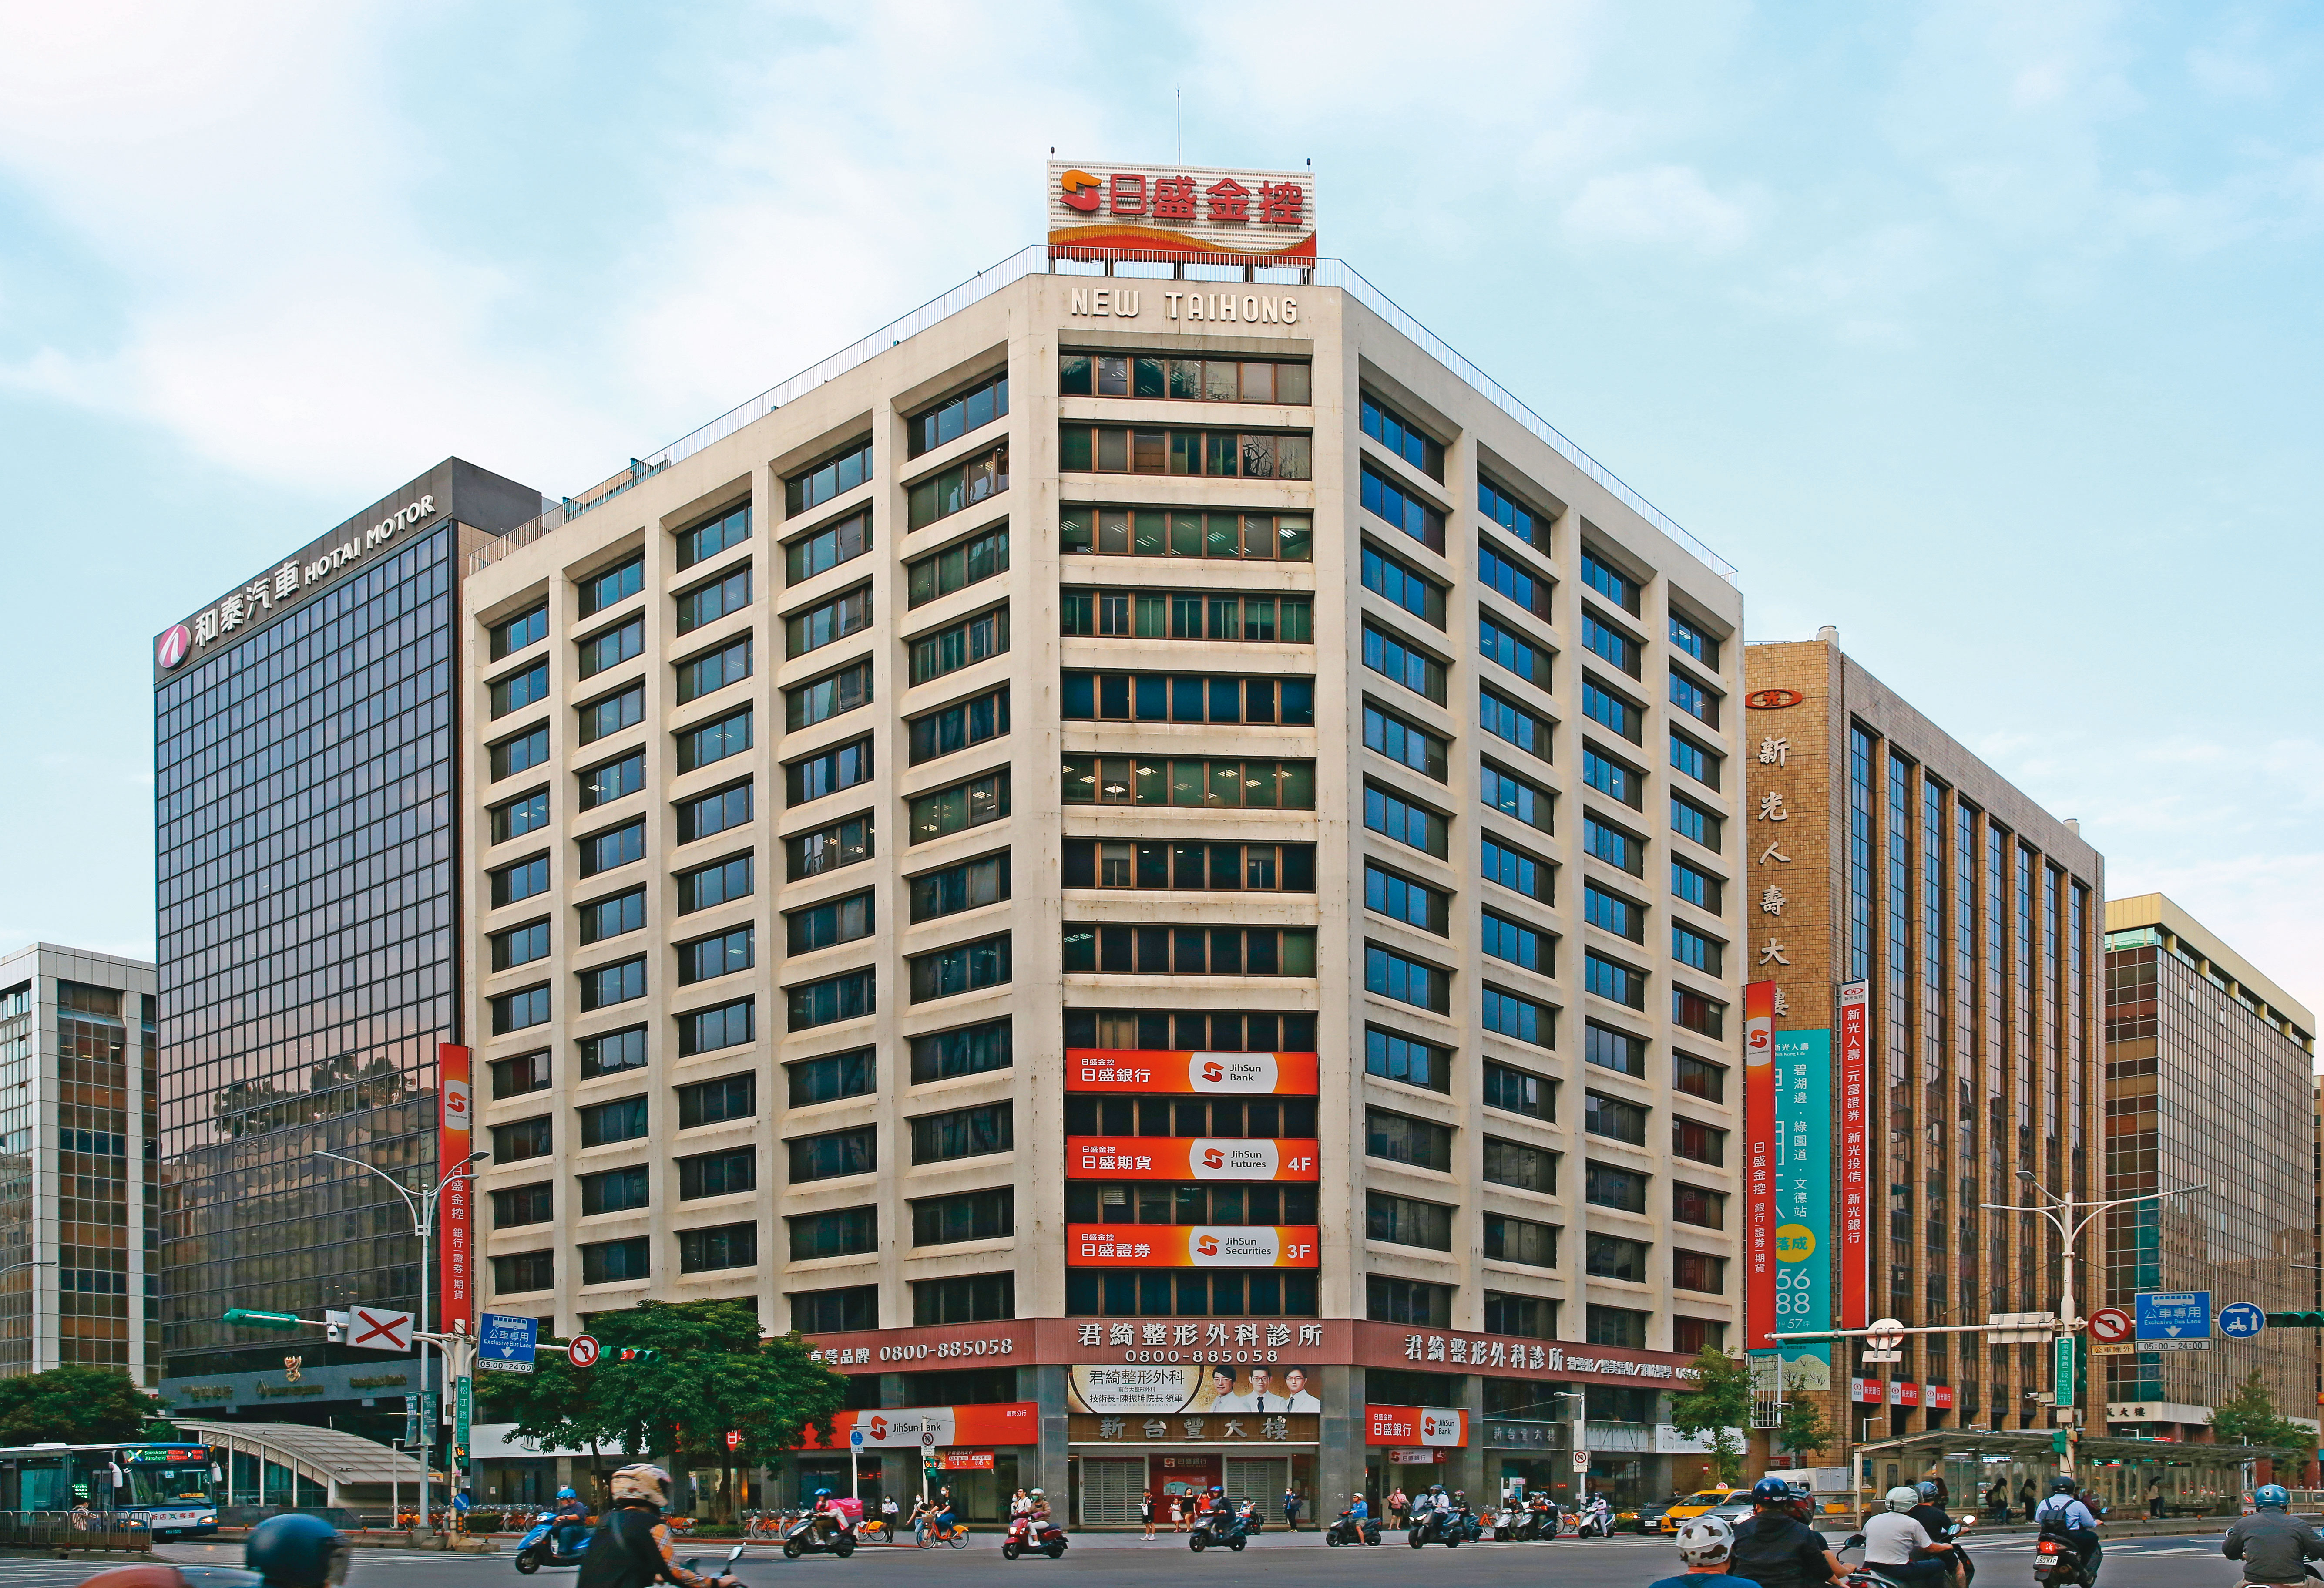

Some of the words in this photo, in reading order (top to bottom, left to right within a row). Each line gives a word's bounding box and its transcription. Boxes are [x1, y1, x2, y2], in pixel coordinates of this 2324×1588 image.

[1110, 174, 1303, 225] 日盛金控
[1071, 287, 1139, 317] NEW
[1165, 291, 1297, 323] TAIHONG
[305, 537, 361, 585] HOTAI
[366, 495, 436, 550] MOTOR
[195, 559, 300, 647] 和泰汽車
[1847, 1009, 1860, 1061] 新光人壽
[1081, 1068, 1151, 1083] 日盛銀行
[1230, 1063, 1262, 1073] JihSun
[1230, 1073, 1254, 1081] Bank
[1847, 1070, 1860, 1122] 元富證券
[1231, 1150, 1262, 1158] JihSun
[1847, 1132, 1861, 1183] 新光投信
[1082, 1155, 1152, 1171] 日盛期貨
[1231, 1160, 1266, 1168] Futures
[1288, 1157, 1312, 1171] 4F
[1753, 1141, 1766, 1195] 日盛金控
[1847, 1193, 1861, 1244] 新光銀行
[1226, 1237, 1257, 1245] JihSun
[1776, 1236, 1808, 1251] 落成
[1081, 1243, 1151, 1258] 日盛證券
[1226, 1246, 1271, 1255] Securities
[1287, 1245, 1311, 1258] 3F
[2144, 1307, 2201, 1319] 公車專用
[489, 1329, 529, 1342] 公車專用
[1077, 1322, 1323, 1346] 君綺整形外科診所
[879, 1339, 1013, 1362] 0800-885058
[1125, 1350, 1279, 1363] 0800-885058
[1405, 1334, 1563, 1372] 君綺整形外科診所
[2095, 1346, 2132, 1354] 公車除外
[1089, 1369, 1185, 1385] 君綺整形外科
[459, 1386, 467, 1419] 松江路
[892, 1423, 918, 1433] JihSun
[1099, 1416, 1289, 1440] 新台豐大樓
[1374, 1423, 1411, 1437] 日盛銀行
